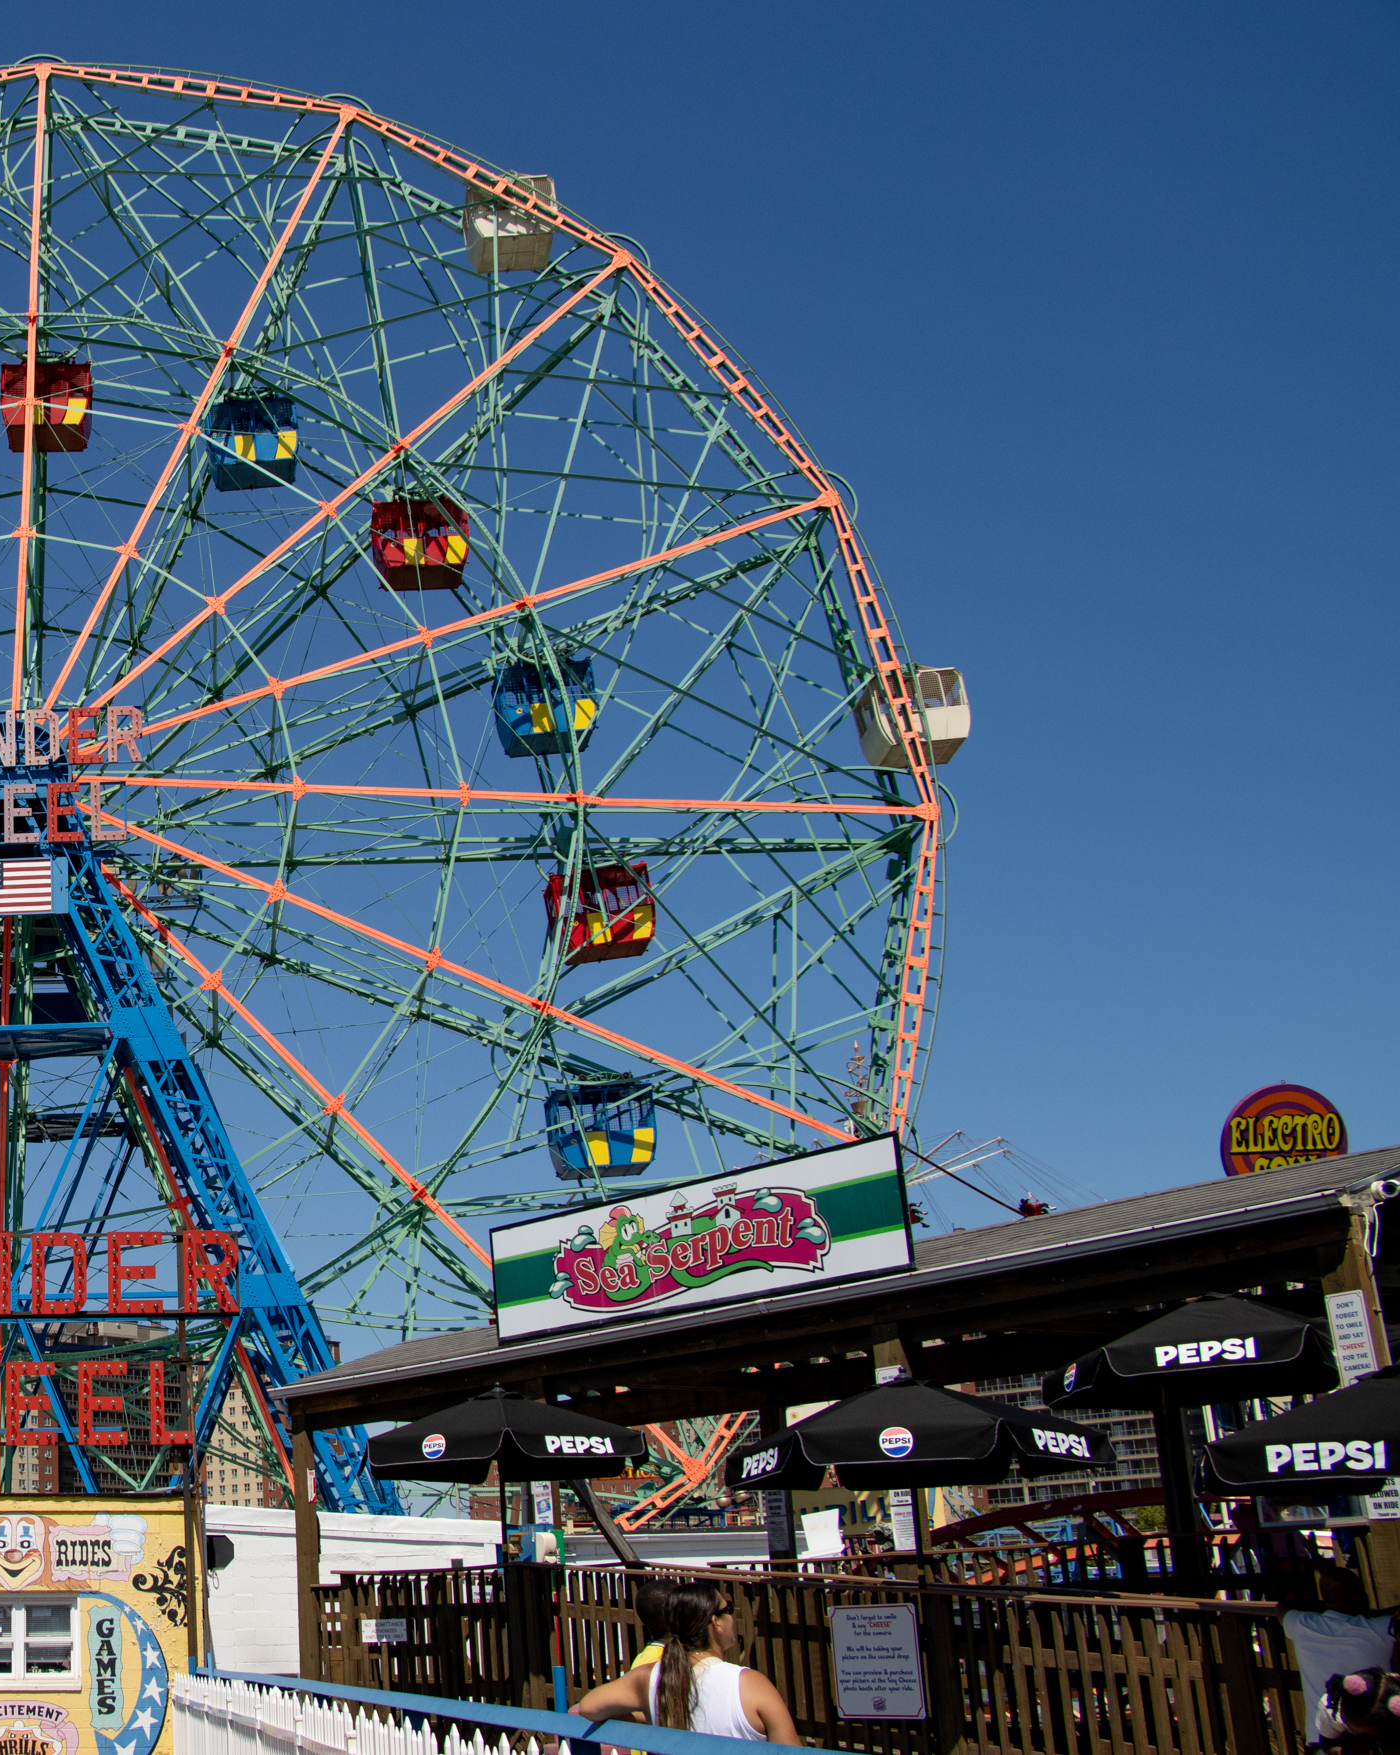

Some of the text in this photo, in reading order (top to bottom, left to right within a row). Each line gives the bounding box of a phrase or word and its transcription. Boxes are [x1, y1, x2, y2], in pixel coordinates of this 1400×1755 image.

[1230, 1112, 1341, 1153] ELECTRO
[574, 1206, 796, 1295] Sea Serpent
[1336, 1301, 1354, 1309] DON'T
[1336, 1311, 1358, 1320] FORGET
[1346, 1321, 1362, 1329] SMILE
[1340, 1342, 1366, 1350] "CHEESE"
[1155, 1336, 1257, 1367] PEPSI
[1344, 1363, 1371, 1371] CAMERA!
[545, 1435, 614, 1454] PEPSI
[881, 1437, 911, 1445] PEPSI
[1032, 1428, 1092, 1458] PEPSI
[1265, 1440, 1386, 1473] PEPSI
[741, 1447, 779, 1479] PEPSI
[1383, 1501, 1399, 1509] RIDE
[56, 1539, 112, 1567] RIDES
[861, 1615, 876, 1623] forget
[891, 1646, 903, 1654] your
[841, 1654, 859, 1662] picture
[897, 1653, 910, 1661] drop
[95, 1618, 117, 1715] GAMES
[863, 1669, 882, 1677] preview
[890, 1669, 913, 1677] purchase
[887, 1677, 897, 1685] Say
[889, 1686, 900, 1694] your
